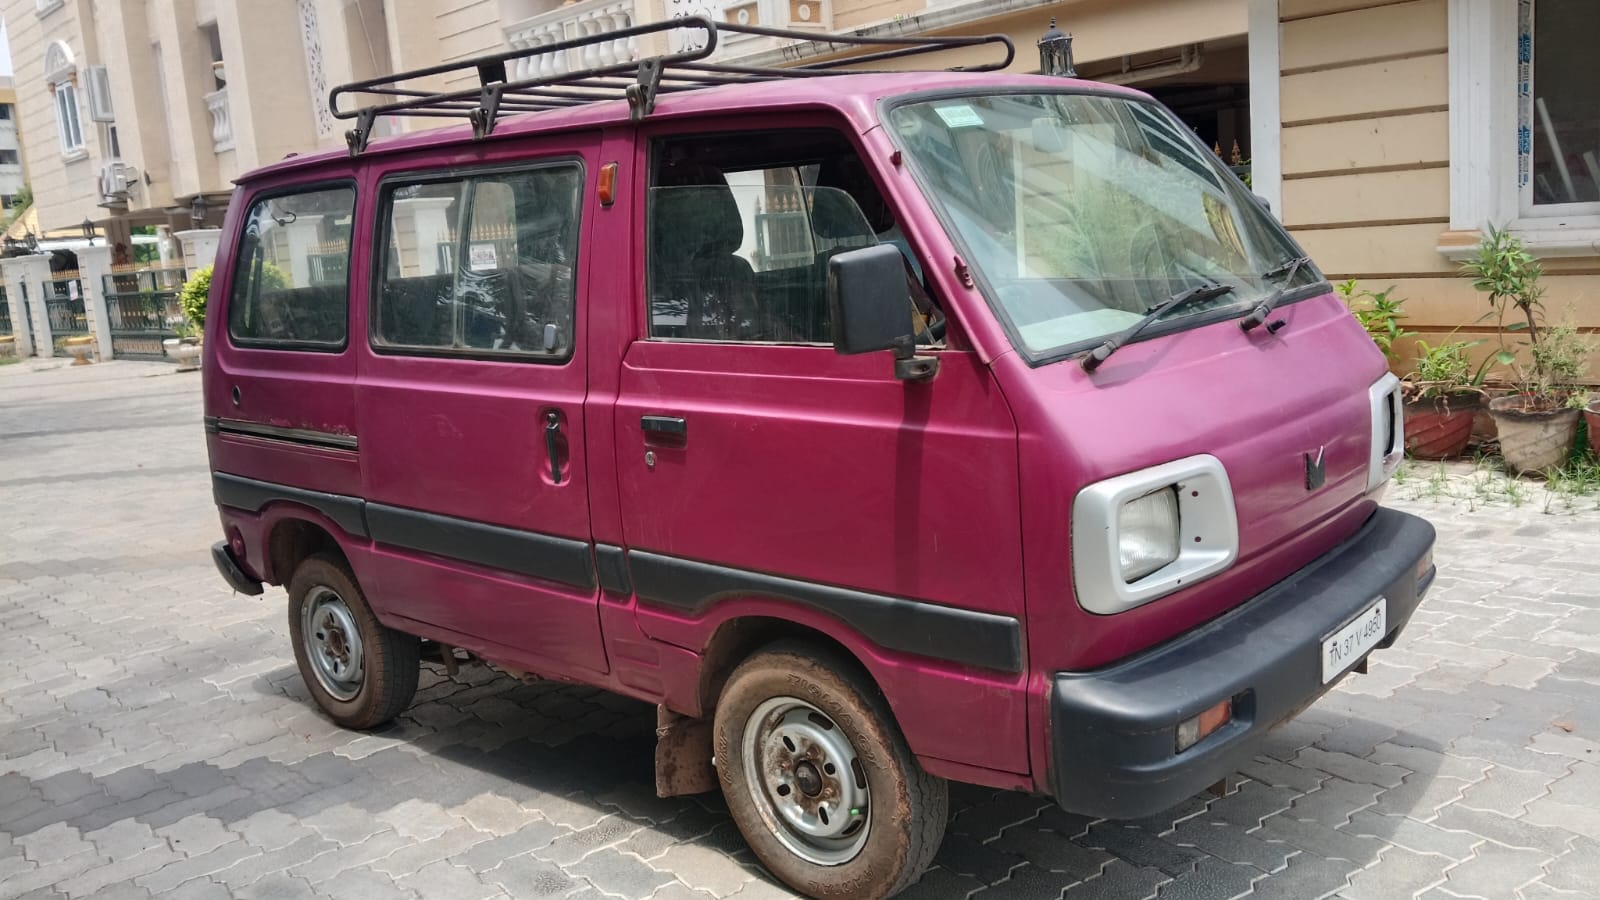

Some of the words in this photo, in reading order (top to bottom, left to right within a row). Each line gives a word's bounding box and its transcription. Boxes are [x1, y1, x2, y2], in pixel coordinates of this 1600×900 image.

[1329, 644, 1341, 667] TN
[1344, 634, 1354, 656] 37
[1356, 628, 1362, 646] V
